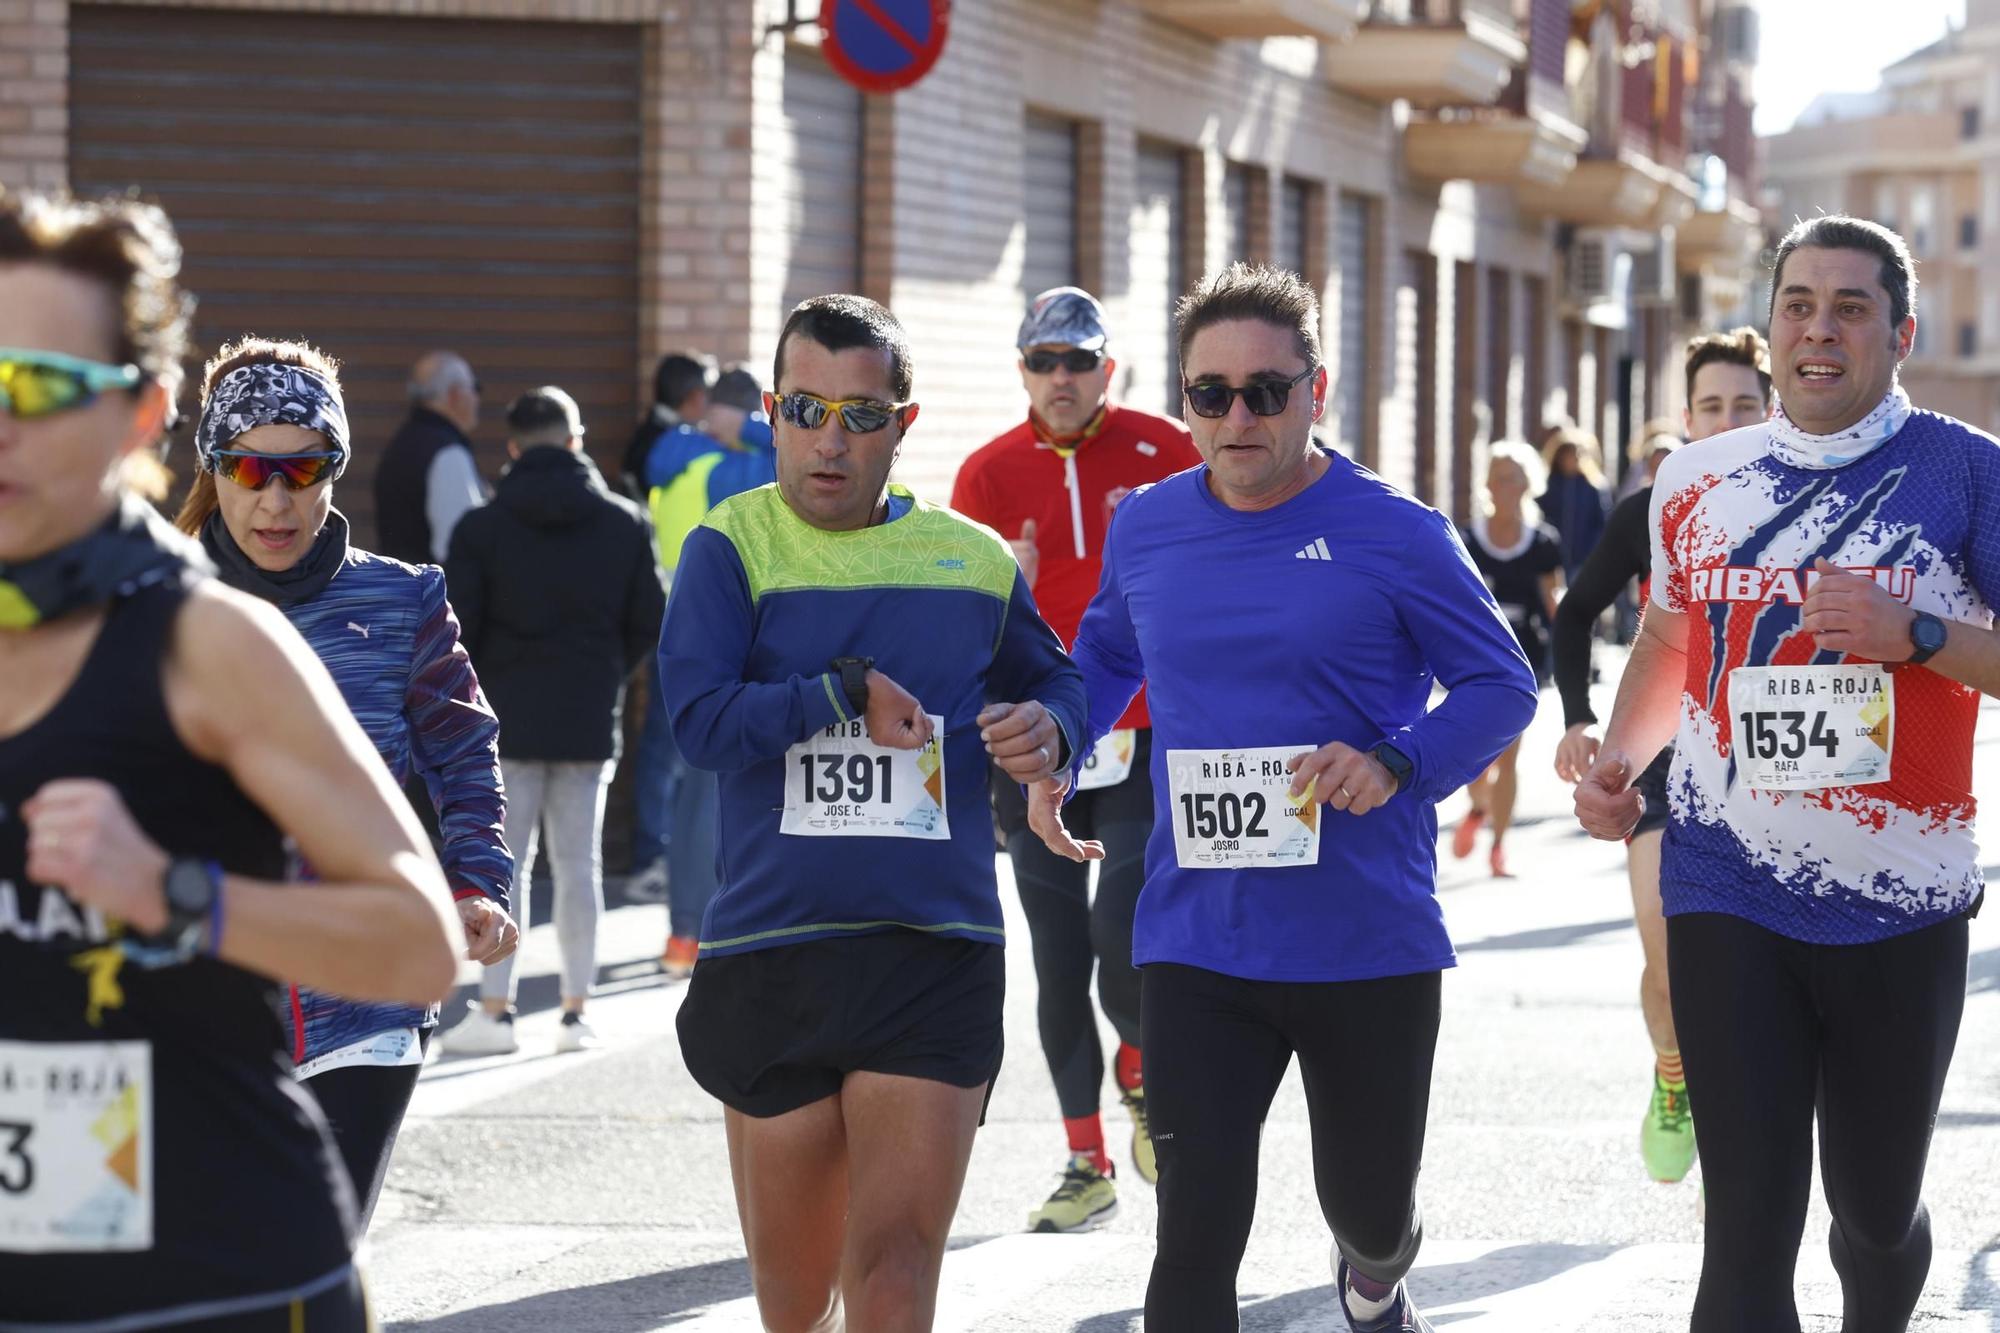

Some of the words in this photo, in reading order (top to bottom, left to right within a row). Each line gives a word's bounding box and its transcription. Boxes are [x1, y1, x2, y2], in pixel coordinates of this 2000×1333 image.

[1740, 711, 1839, 760] 1534
[1855, 727, 1882, 737] LOCAL
[1774, 760, 1799, 772] RAFA
[800, 754, 892, 804] 1391
[824, 805, 851, 817] JOSE
[854, 805, 865, 817] C.
[1180, 791, 1269, 839] 1502
[1284, 807, 1310, 817] LOCAL
[1211, 839, 1240, 851] JOSRO
